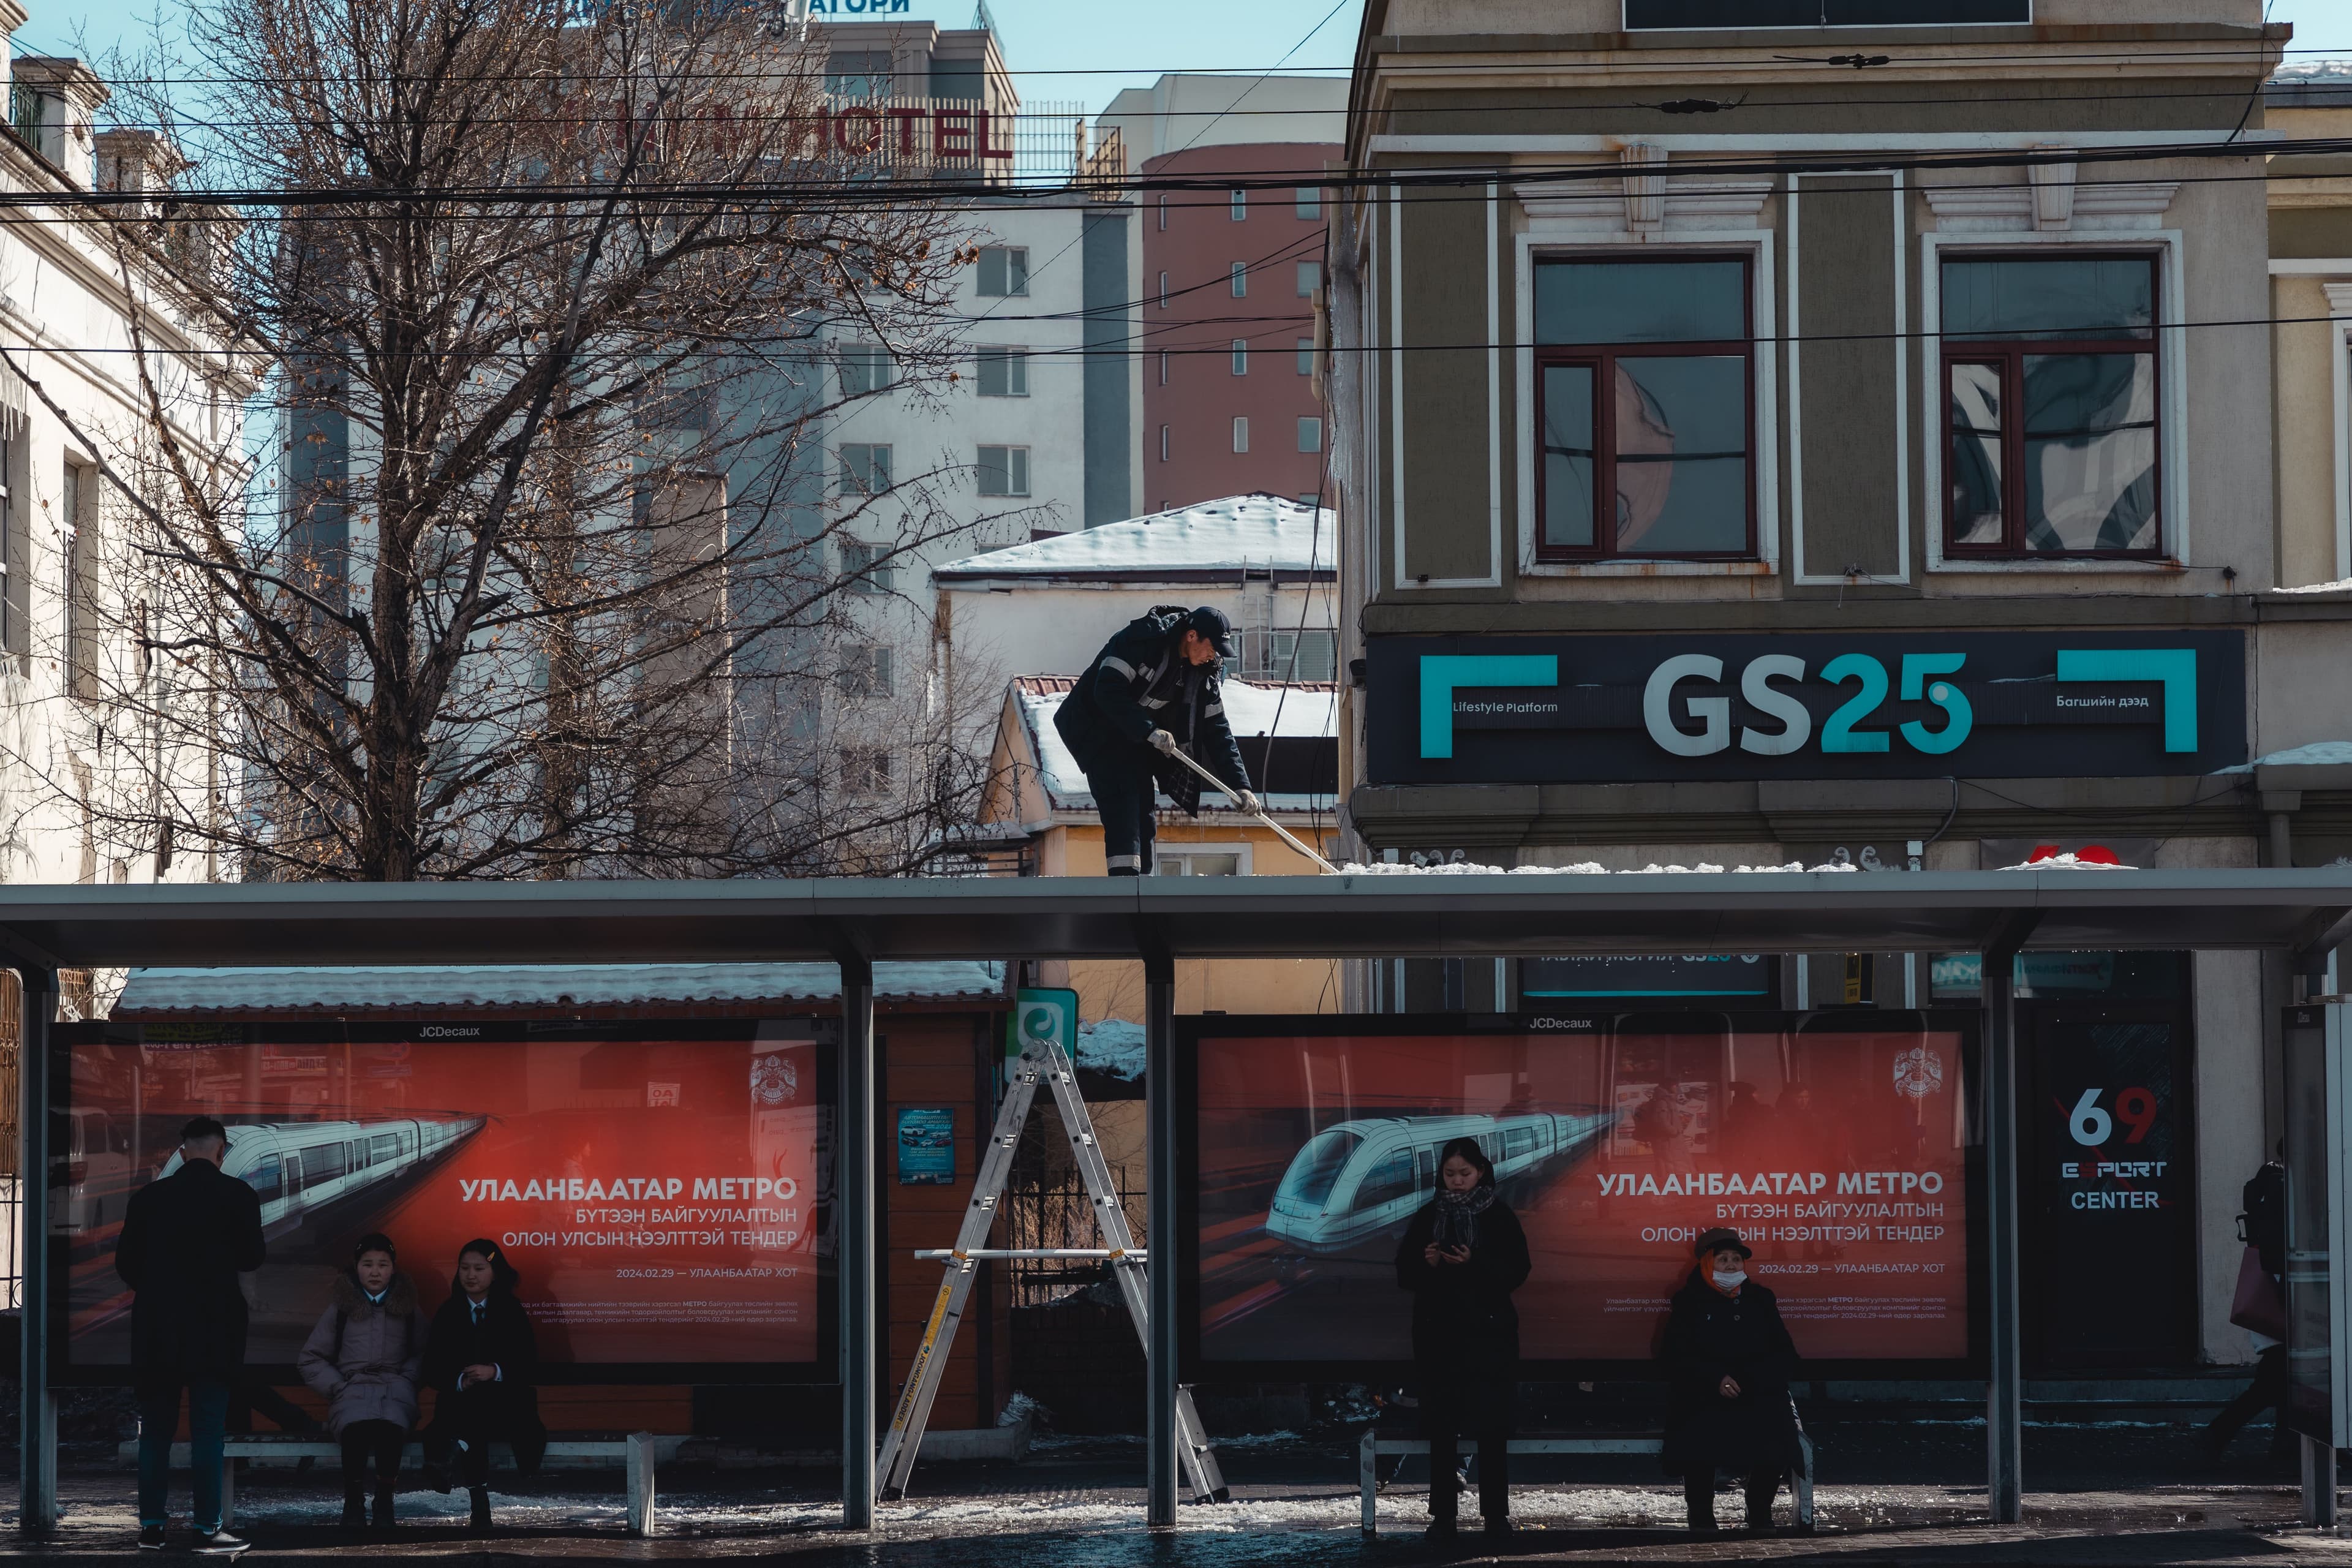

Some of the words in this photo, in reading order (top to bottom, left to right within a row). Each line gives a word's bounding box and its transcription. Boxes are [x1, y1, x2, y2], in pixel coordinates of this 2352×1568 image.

[1453, 702, 1504, 714] Lifestyle
[1506, 703, 1558, 712] Platform
[1643, 652, 1973, 756] GS25
[2057, 695, 2115, 706] Багшийн
[2119, 698, 2149, 707] дээд
[420, 1026, 480, 1038] JCDecaux
[1529, 1017, 1593, 1029] JCDecaux
[2069, 1087, 2157, 1147] 69
[2062, 1161, 2167, 1178] ESPORT
[459, 1177, 683, 1202] УЛААНБААТАР
[692, 1177, 797, 1200] МЕТРО
[1596, 1172, 1826, 1197] УЛААНБААТАР
[1837, 1171, 1943, 1195] МЕТРО
[1716, 1204, 1787, 1219] БҮТЭЭН
[1794, 1200, 1943, 1219] БАЙГУУЛАЛТЫН
[2071, 1191, 2160, 1210] CENTER
[576, 1209, 646, 1224] БҮТЭЭН
[650, 1205, 797, 1223] БАЙГУУЛАЛТЫН
[502, 1231, 556, 1247] ОЛОН
[562, 1231, 624, 1246] УЛСЫН
[630, 1227, 725, 1246] НЭЭЛТТЭЙ
[731, 1231, 797, 1248] ТЕНДЕР
[1641, 1227, 1695, 1242] ОЛОН
[1773, 1223, 1869, 1242] НЭЭЛТТЭЙ
[1875, 1226, 1944, 1243] ТЕНДЕР
[616, 1268, 674, 1278] 2024.02.29
[689, 1268, 773, 1278] УЛААНБААТАР
[775, 1268, 797, 1277] ХОТ
[1758, 1264, 1818, 1274] 2024.02.29
[1834, 1264, 1919, 1273] УЛААНБААТАР
[1923, 1264, 1945, 1273] ХОТ
[897, 1353, 925, 1422] JOONGANG-LADDER
